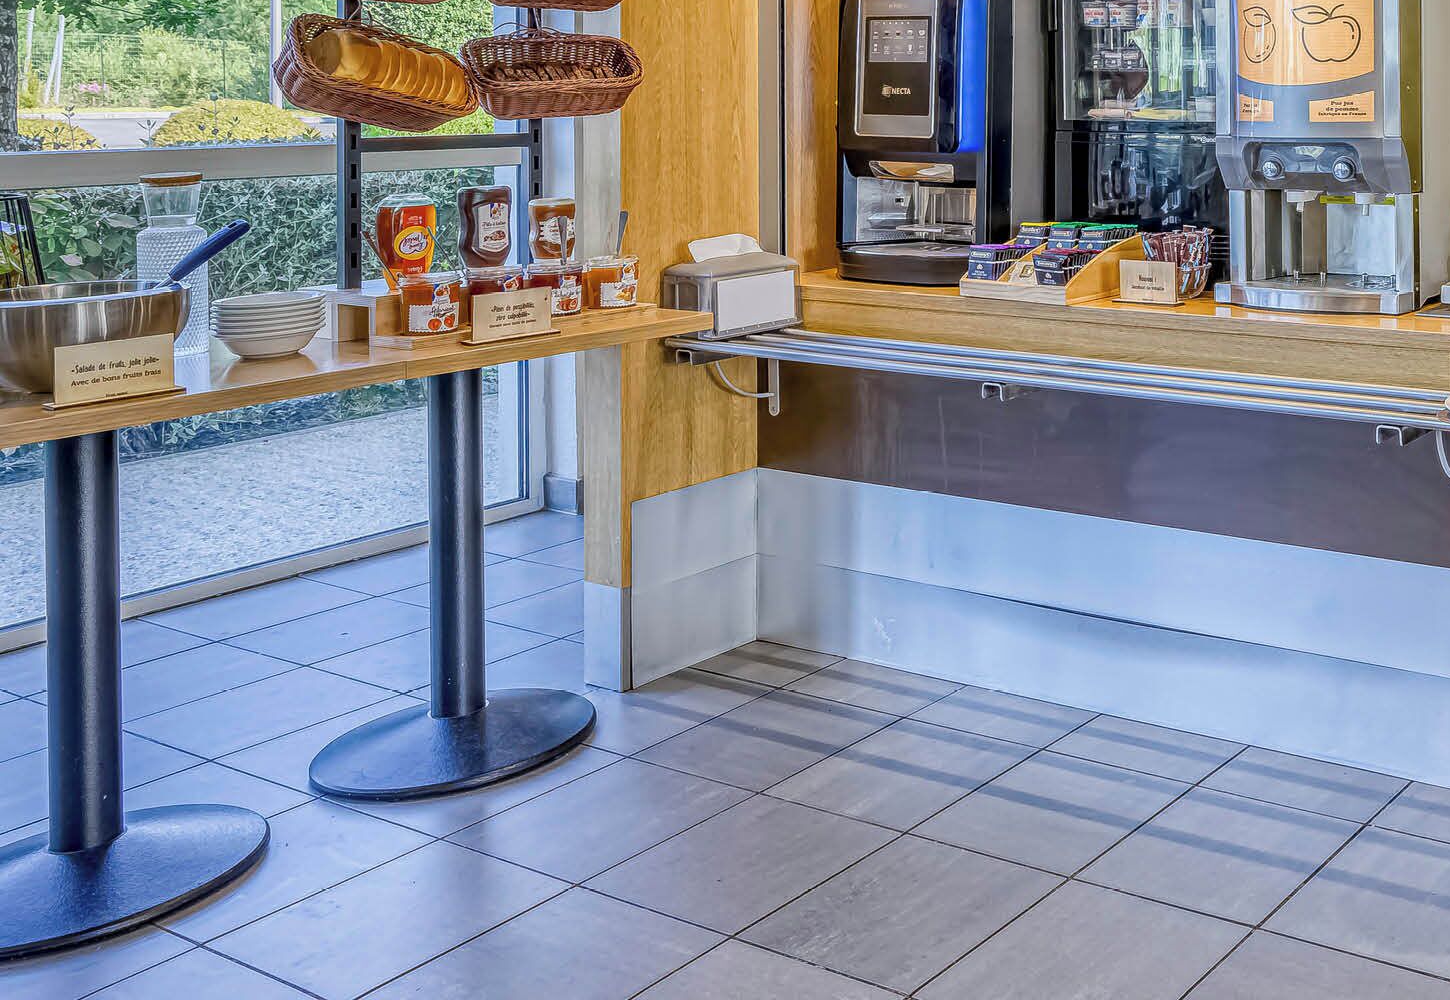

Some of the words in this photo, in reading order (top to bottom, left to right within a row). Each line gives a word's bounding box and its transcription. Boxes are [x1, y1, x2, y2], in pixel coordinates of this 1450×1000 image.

[891, 87, 911, 95] NECTA
[98, 362, 106, 371] de
[71, 379, 90, 387] Avec
[102, 374, 121, 383] bons
[122, 371, 143, 380] fruits
[144, 369, 161, 377] frais
